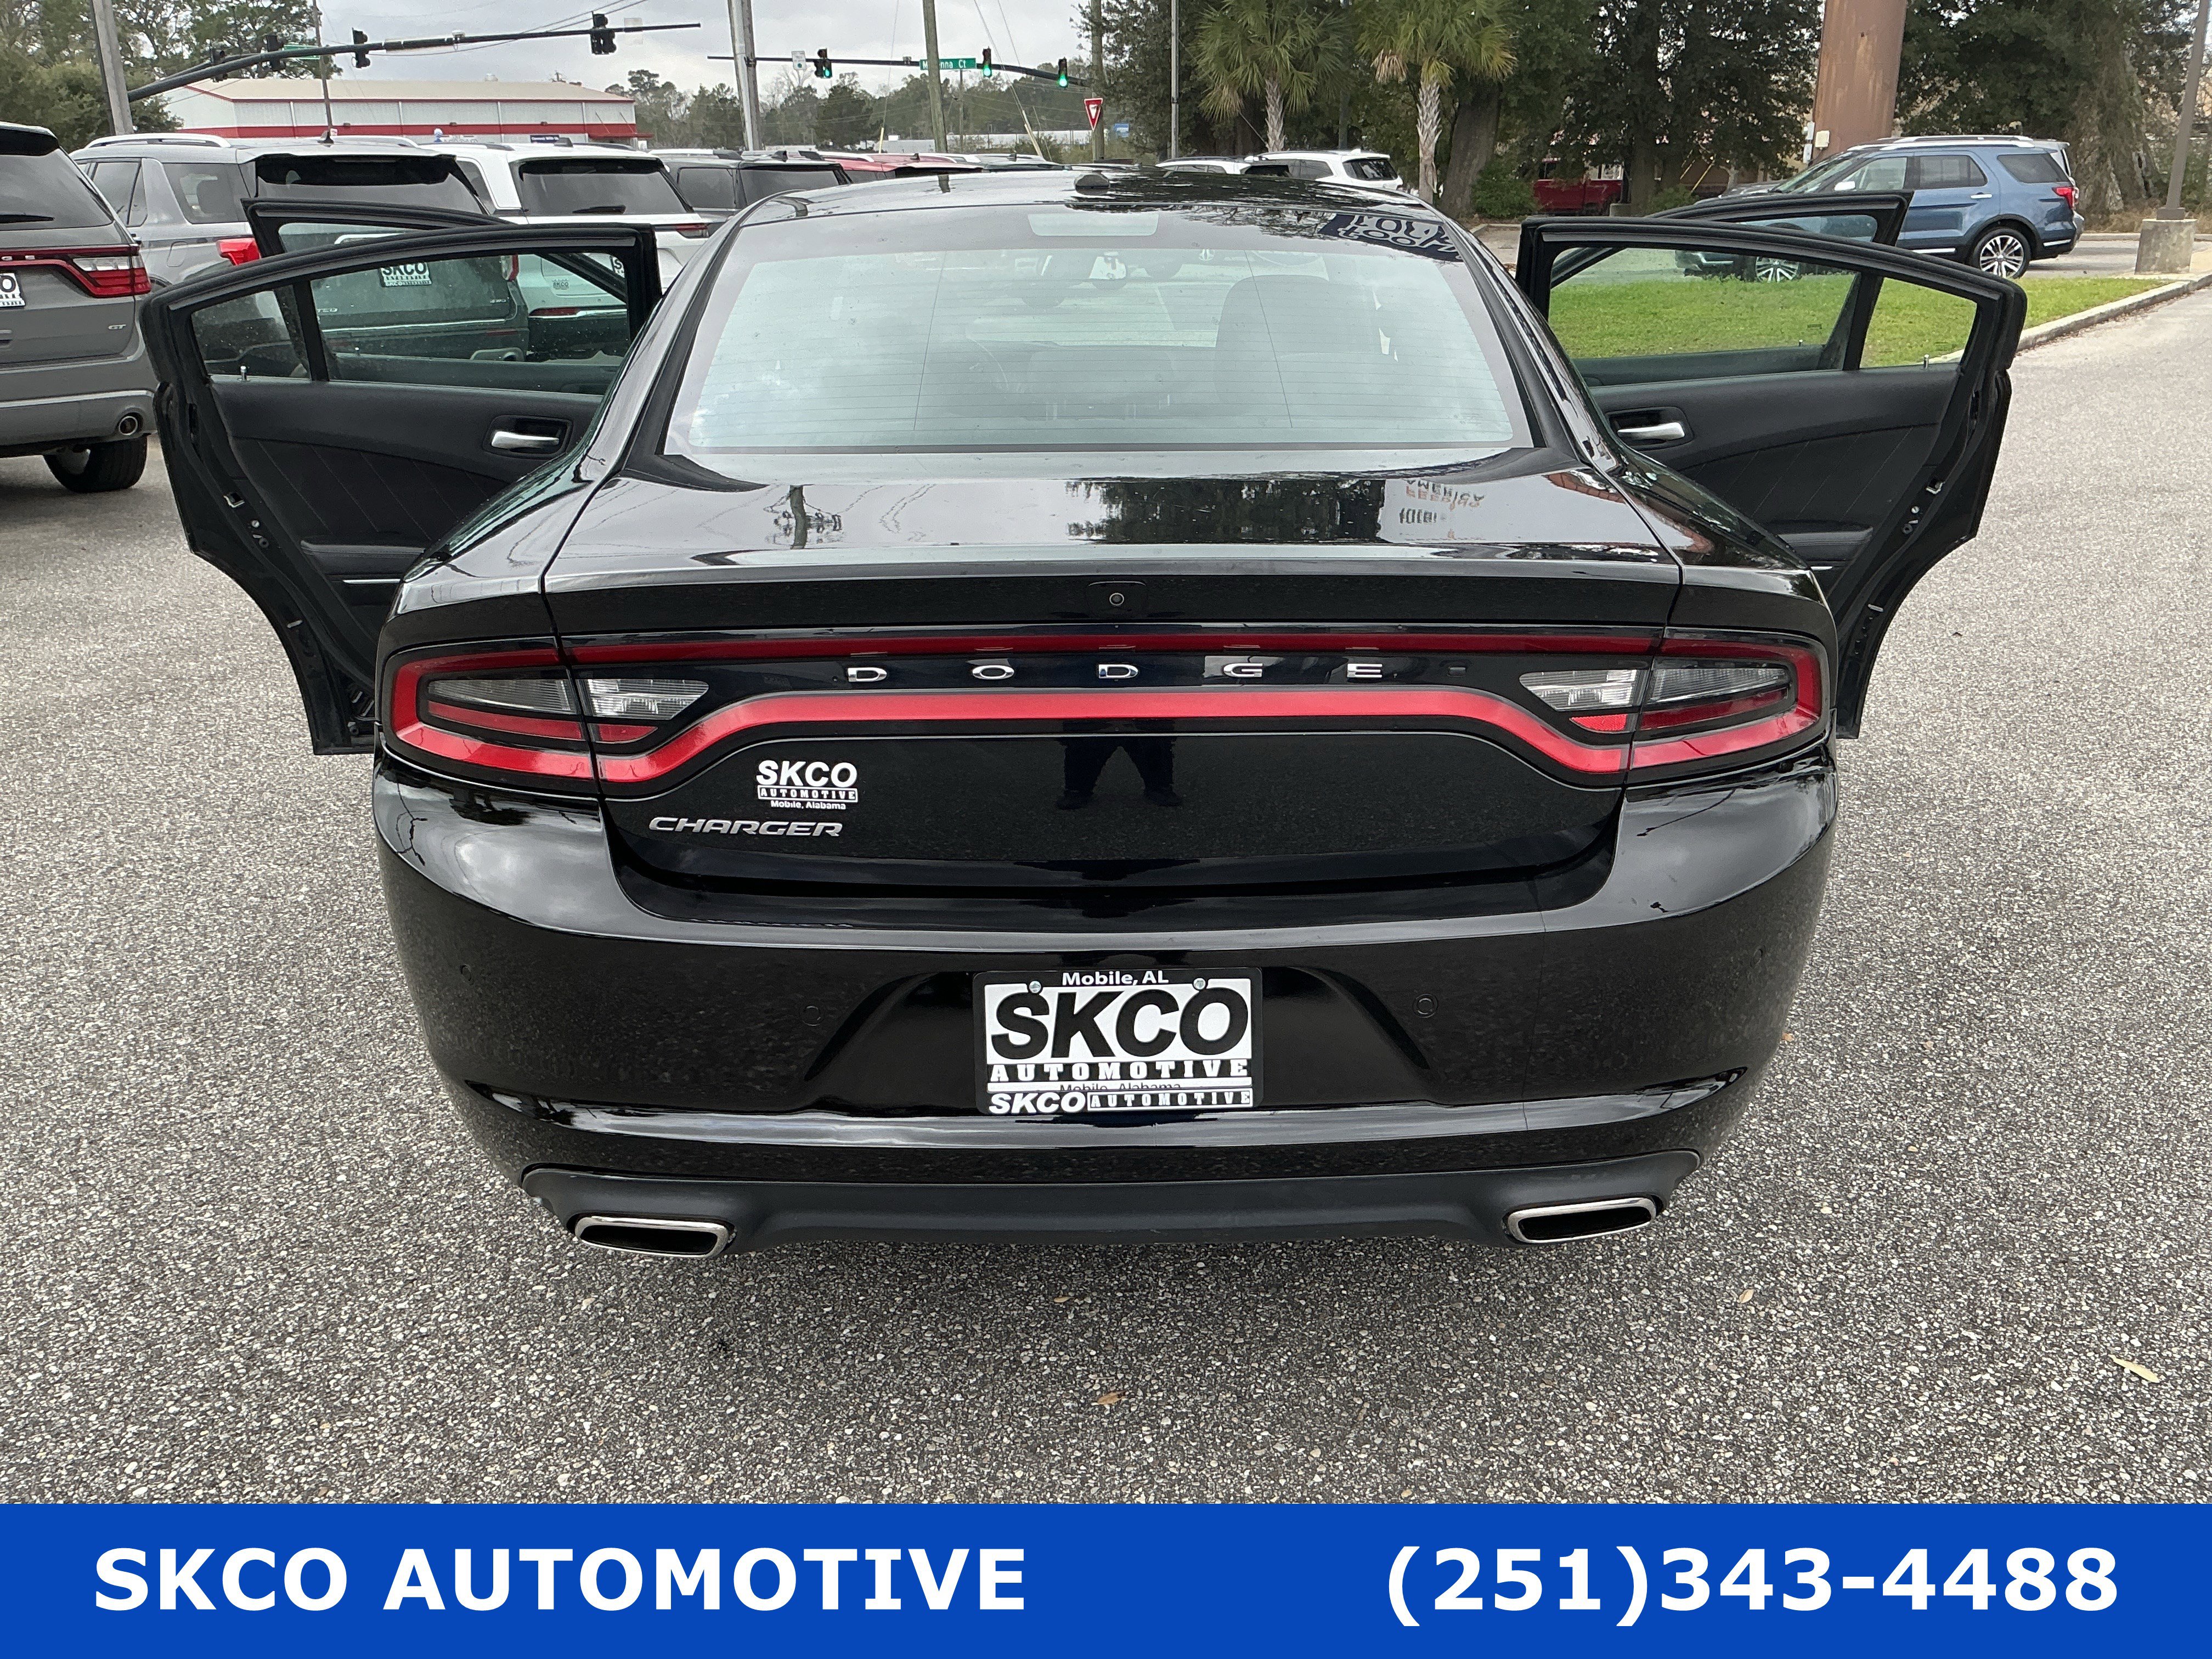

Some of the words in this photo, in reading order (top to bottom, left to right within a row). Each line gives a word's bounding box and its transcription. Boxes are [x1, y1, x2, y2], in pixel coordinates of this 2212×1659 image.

[958, 59, 966, 69] Ct
[848, 663, 1383, 683] DODGE
[756, 760, 857, 788] SKCO
[760, 788, 855, 799] AUTOMOTIVE
[771, 800, 804, 809] Mobile,
[806, 801, 846, 810] Alabama
[649, 816, 843, 837] CHARGER
[1062, 970, 1138, 986] Mobile,
[1142, 970, 1169, 984] AL
[991, 988, 1249, 1059] SKCO
[990, 1059, 1248, 1082] AUTOMOTIVE
[989, 1092, 1086, 1114] SKCO
[1091, 1092, 1250, 1108] AUTOMOTIVE
